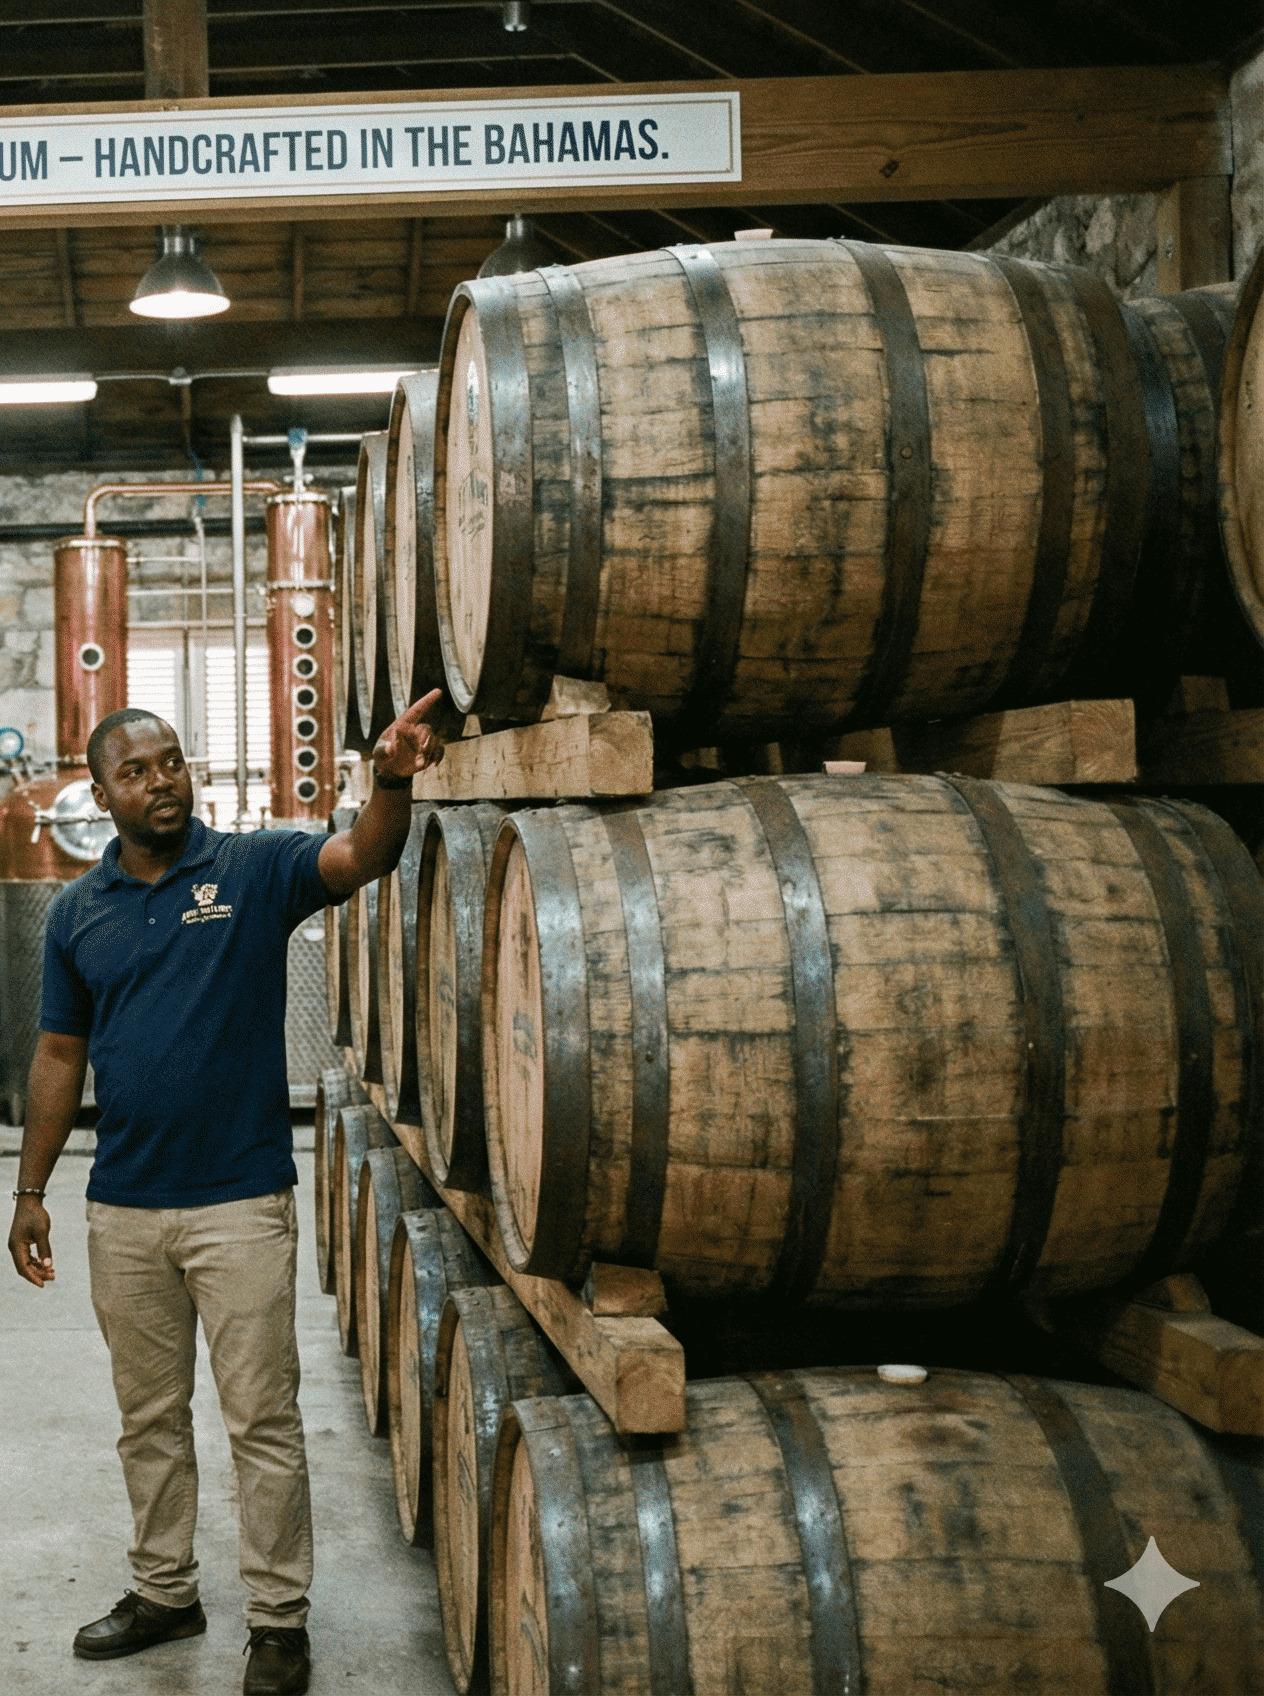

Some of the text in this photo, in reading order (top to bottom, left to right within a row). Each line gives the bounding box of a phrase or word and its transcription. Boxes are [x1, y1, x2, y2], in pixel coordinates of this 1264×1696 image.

[94, 129, 348, 178] HANDCRAFTED
[360, 127, 393, 169] IN
[404, 124, 472, 167] THE
[484, 117, 670, 165] BAHAMAS.
